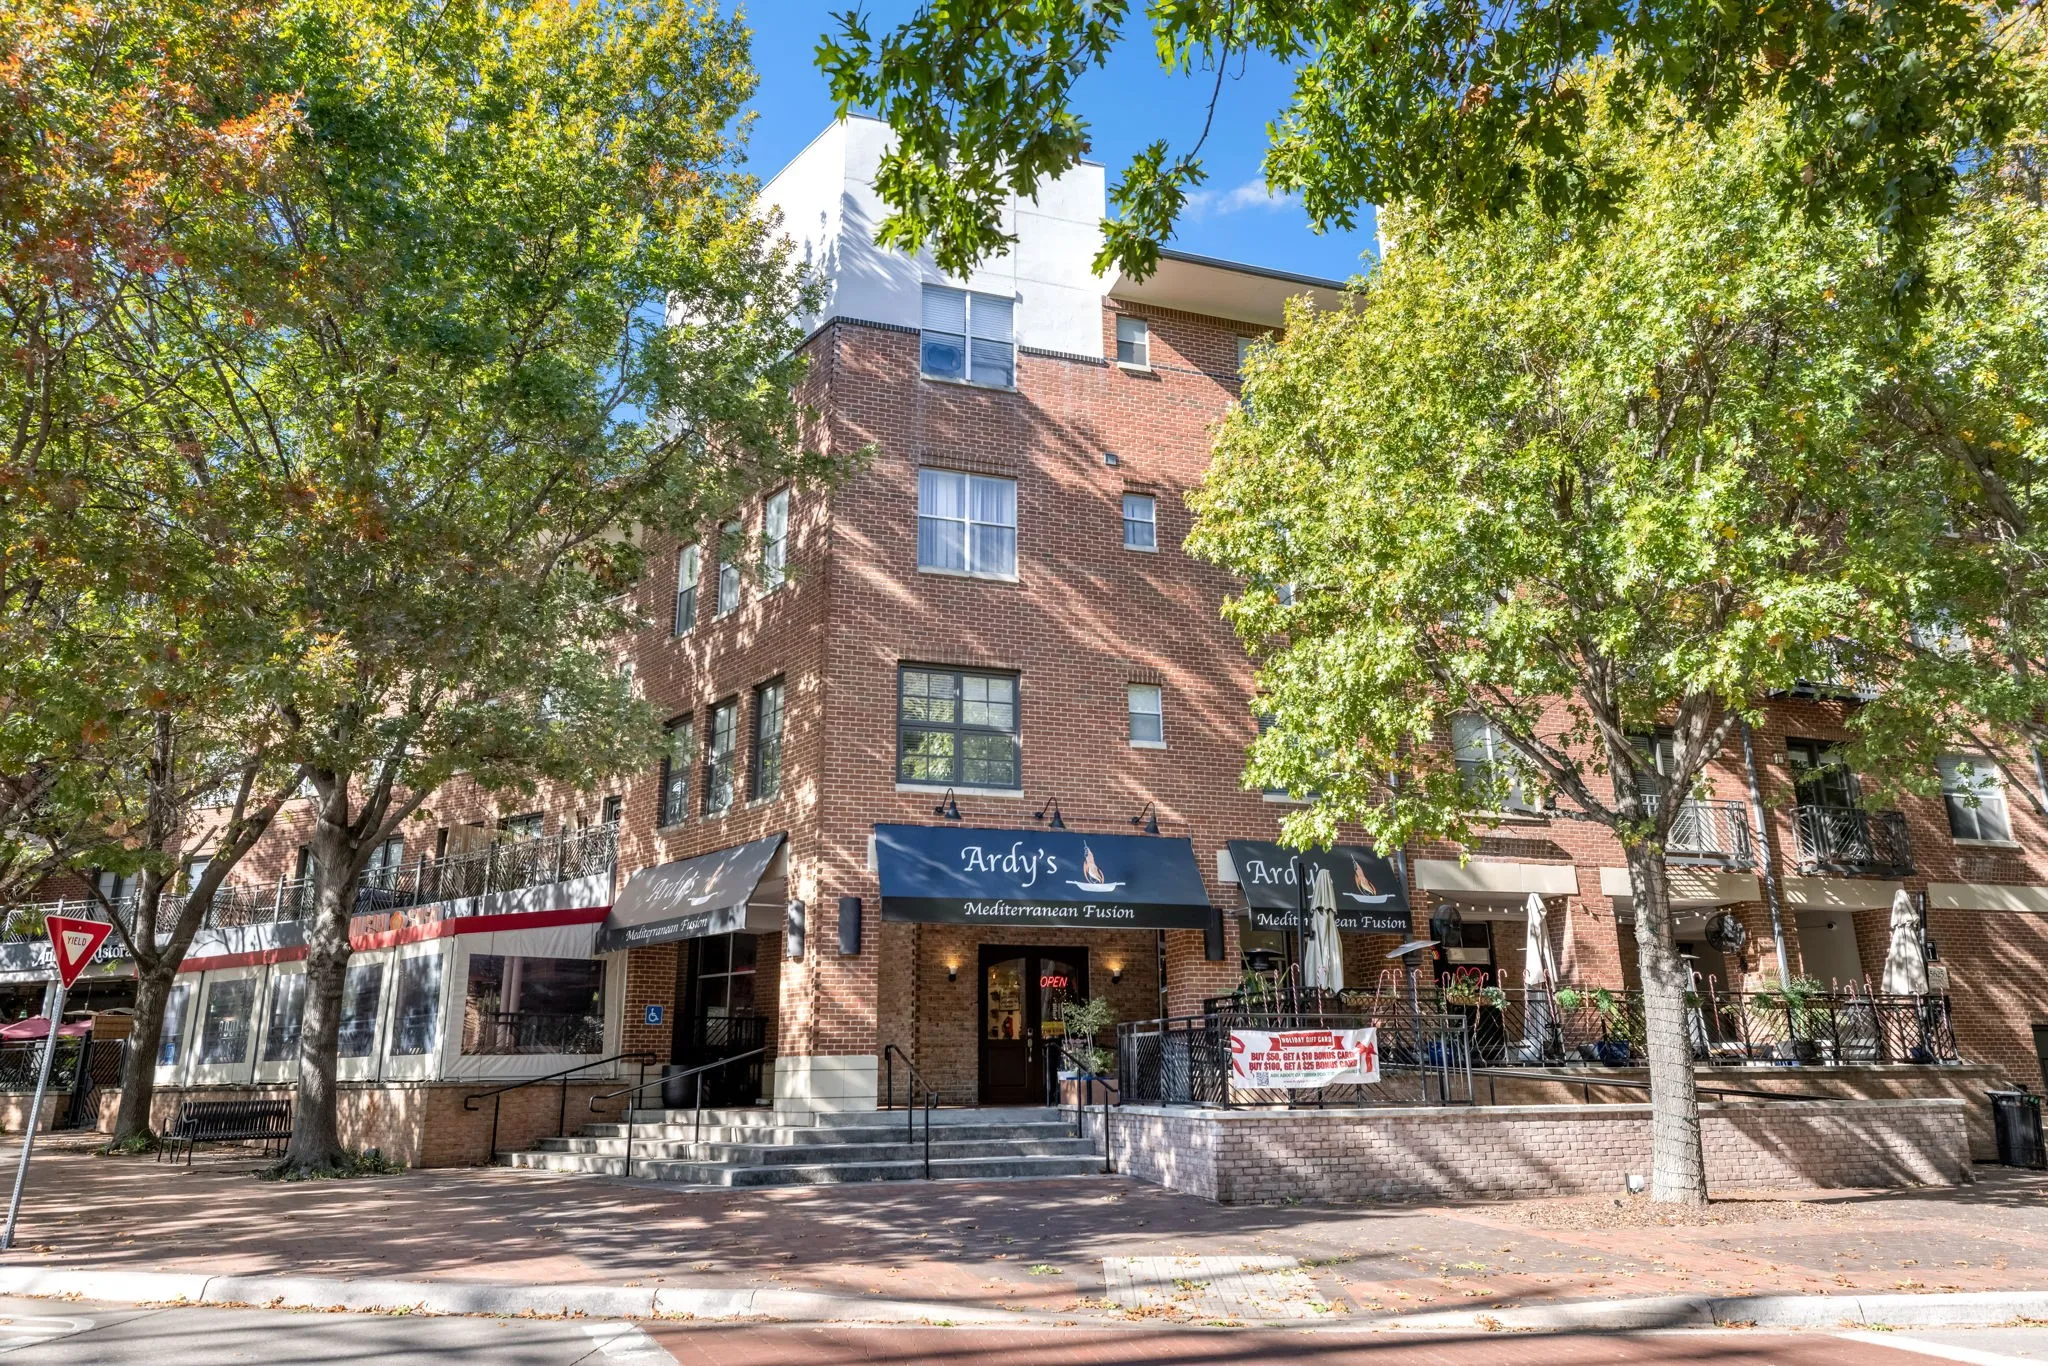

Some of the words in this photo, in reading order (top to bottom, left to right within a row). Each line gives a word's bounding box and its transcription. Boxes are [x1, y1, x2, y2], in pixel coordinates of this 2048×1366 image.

[961, 841, 1058, 887] Ardy's
[1246, 855, 1333, 899] Ardy'
[645, 866, 701, 910] Ardy's
[963, 900, 1078, 919] Mediterranean
[1082, 904, 1135, 919] Fusion
[626, 925, 679, 943] Mediterranean
[680, 916, 708, 932] Fusion
[1361, 915, 1407, 929] Fusion
[67, 935, 87, 946] YIELD
[1040, 976, 1068, 988] OPEN
[1251, 1052, 1265, 1061] BUY
[1267, 1052, 1282, 1062] $50,
[1283, 1052, 1295, 1061] GET
[1296, 1052, 1300, 1060] A
[1302, 1051, 1313, 1061] $10
[1314, 1051, 1335, 1060] BONUS
[1249, 1062, 1262, 1071] BUY
[1264, 1062, 1282, 1071] $100,
[1284, 1062, 1296, 1070] GET
[1297, 1061, 1301, 1070] A
[1303, 1061, 1315, 1070] $25
[1316, 1060, 1338, 1069] BONUS
